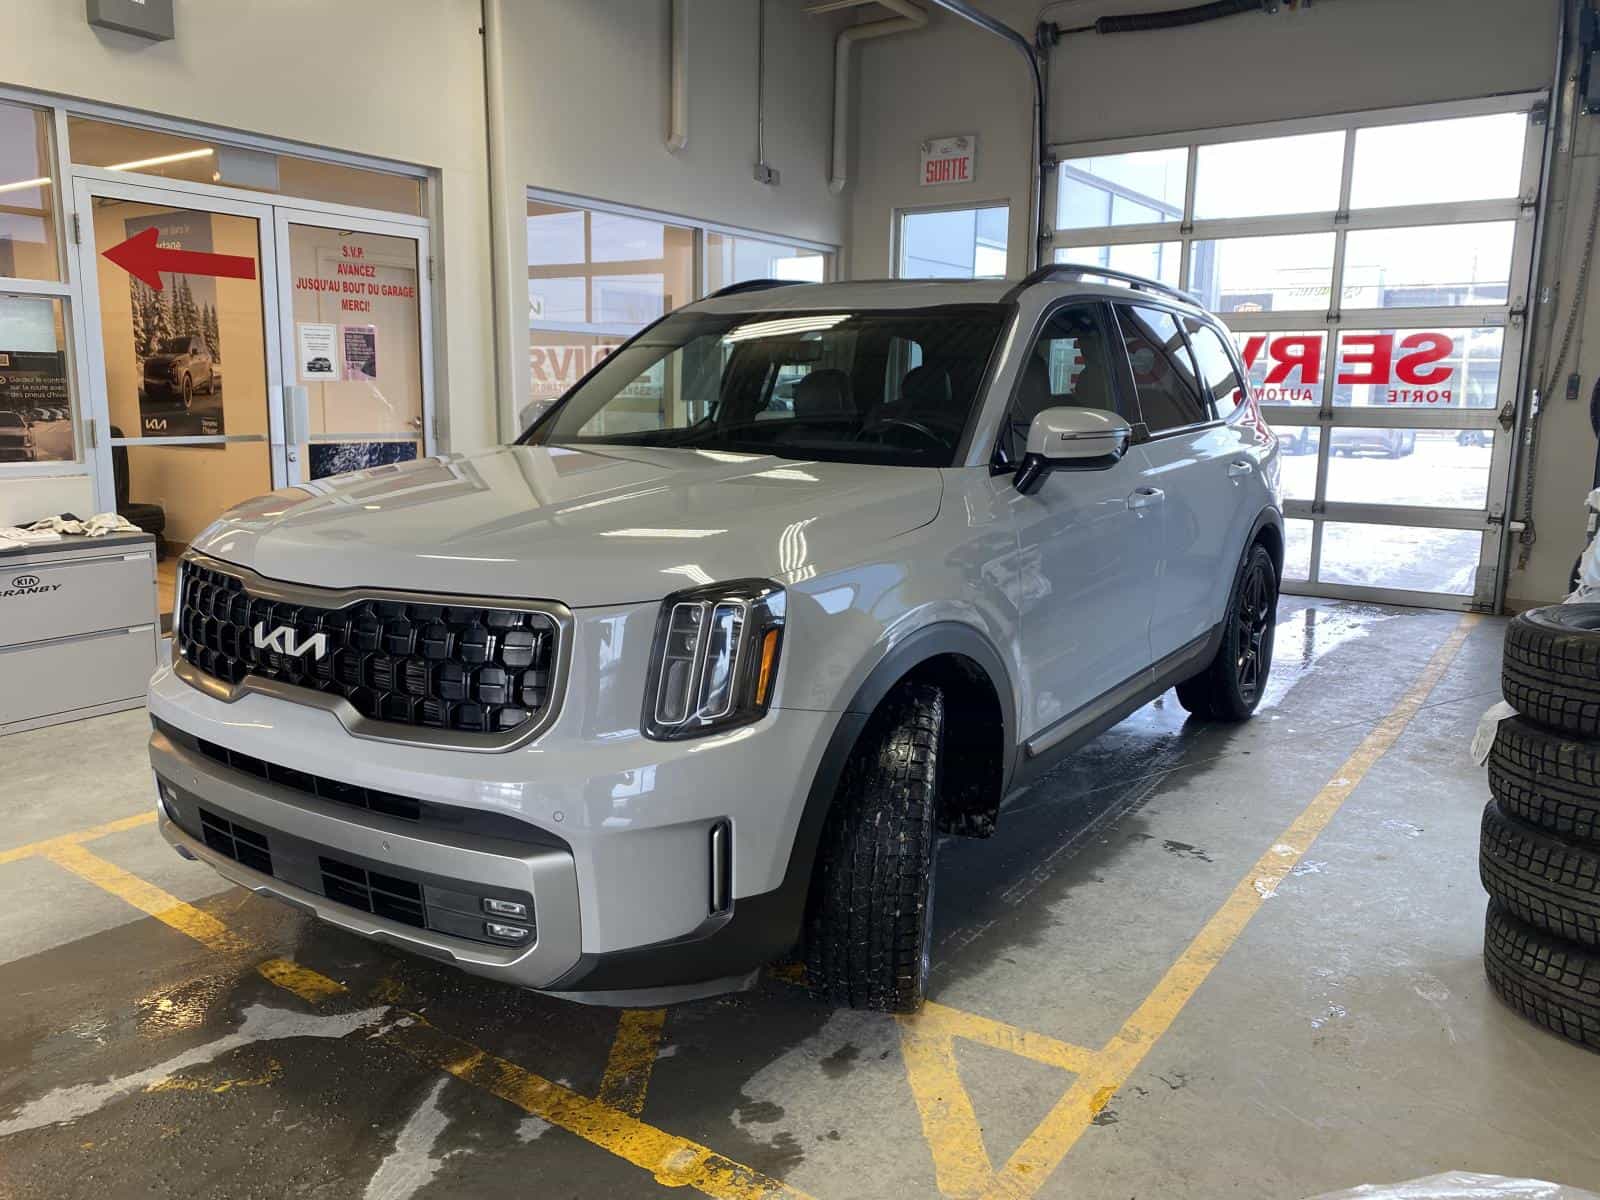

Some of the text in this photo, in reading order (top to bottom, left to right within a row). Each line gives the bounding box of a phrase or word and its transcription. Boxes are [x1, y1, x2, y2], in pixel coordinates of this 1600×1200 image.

[926, 156, 969, 183] SORTIE
[342, 245, 364, 259] S.V.P.
[337, 263, 376, 278] AVANCEZ
[296, 277, 416, 299] JUSQU'AU BOUT DU GARAGE
[341, 299, 370, 313] MERCI!
[145, 418, 168, 431] KIA
[0, 584, 62, 597] RANBY
[254, 621, 326, 661] KIA
